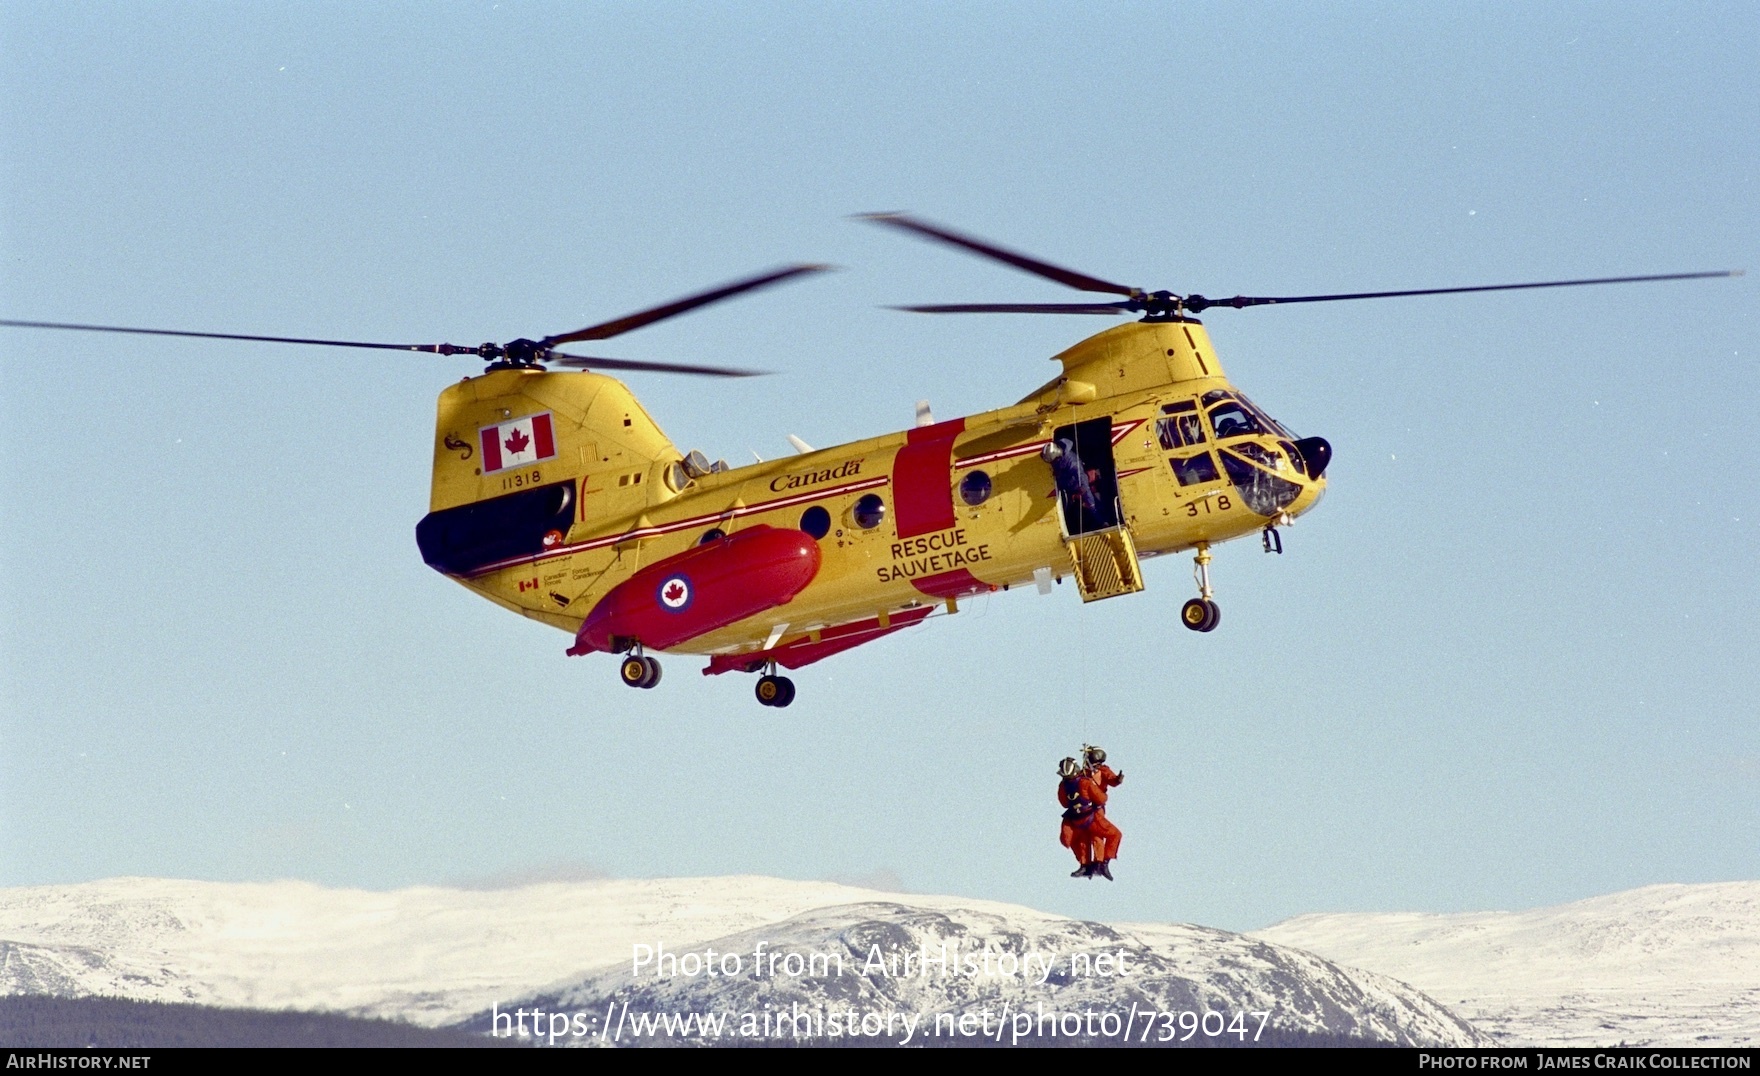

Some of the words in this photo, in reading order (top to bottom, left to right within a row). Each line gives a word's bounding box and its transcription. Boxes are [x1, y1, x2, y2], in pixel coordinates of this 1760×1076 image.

[1119, 369, 1125, 377] 2
[502, 470, 541, 490] 11318
[769, 458, 865, 492] Canada
[1185, 495, 1231, 517] 318
[891, 529, 967, 560] RESCUE
[877, 544, 992, 583] SAUVETAGE
